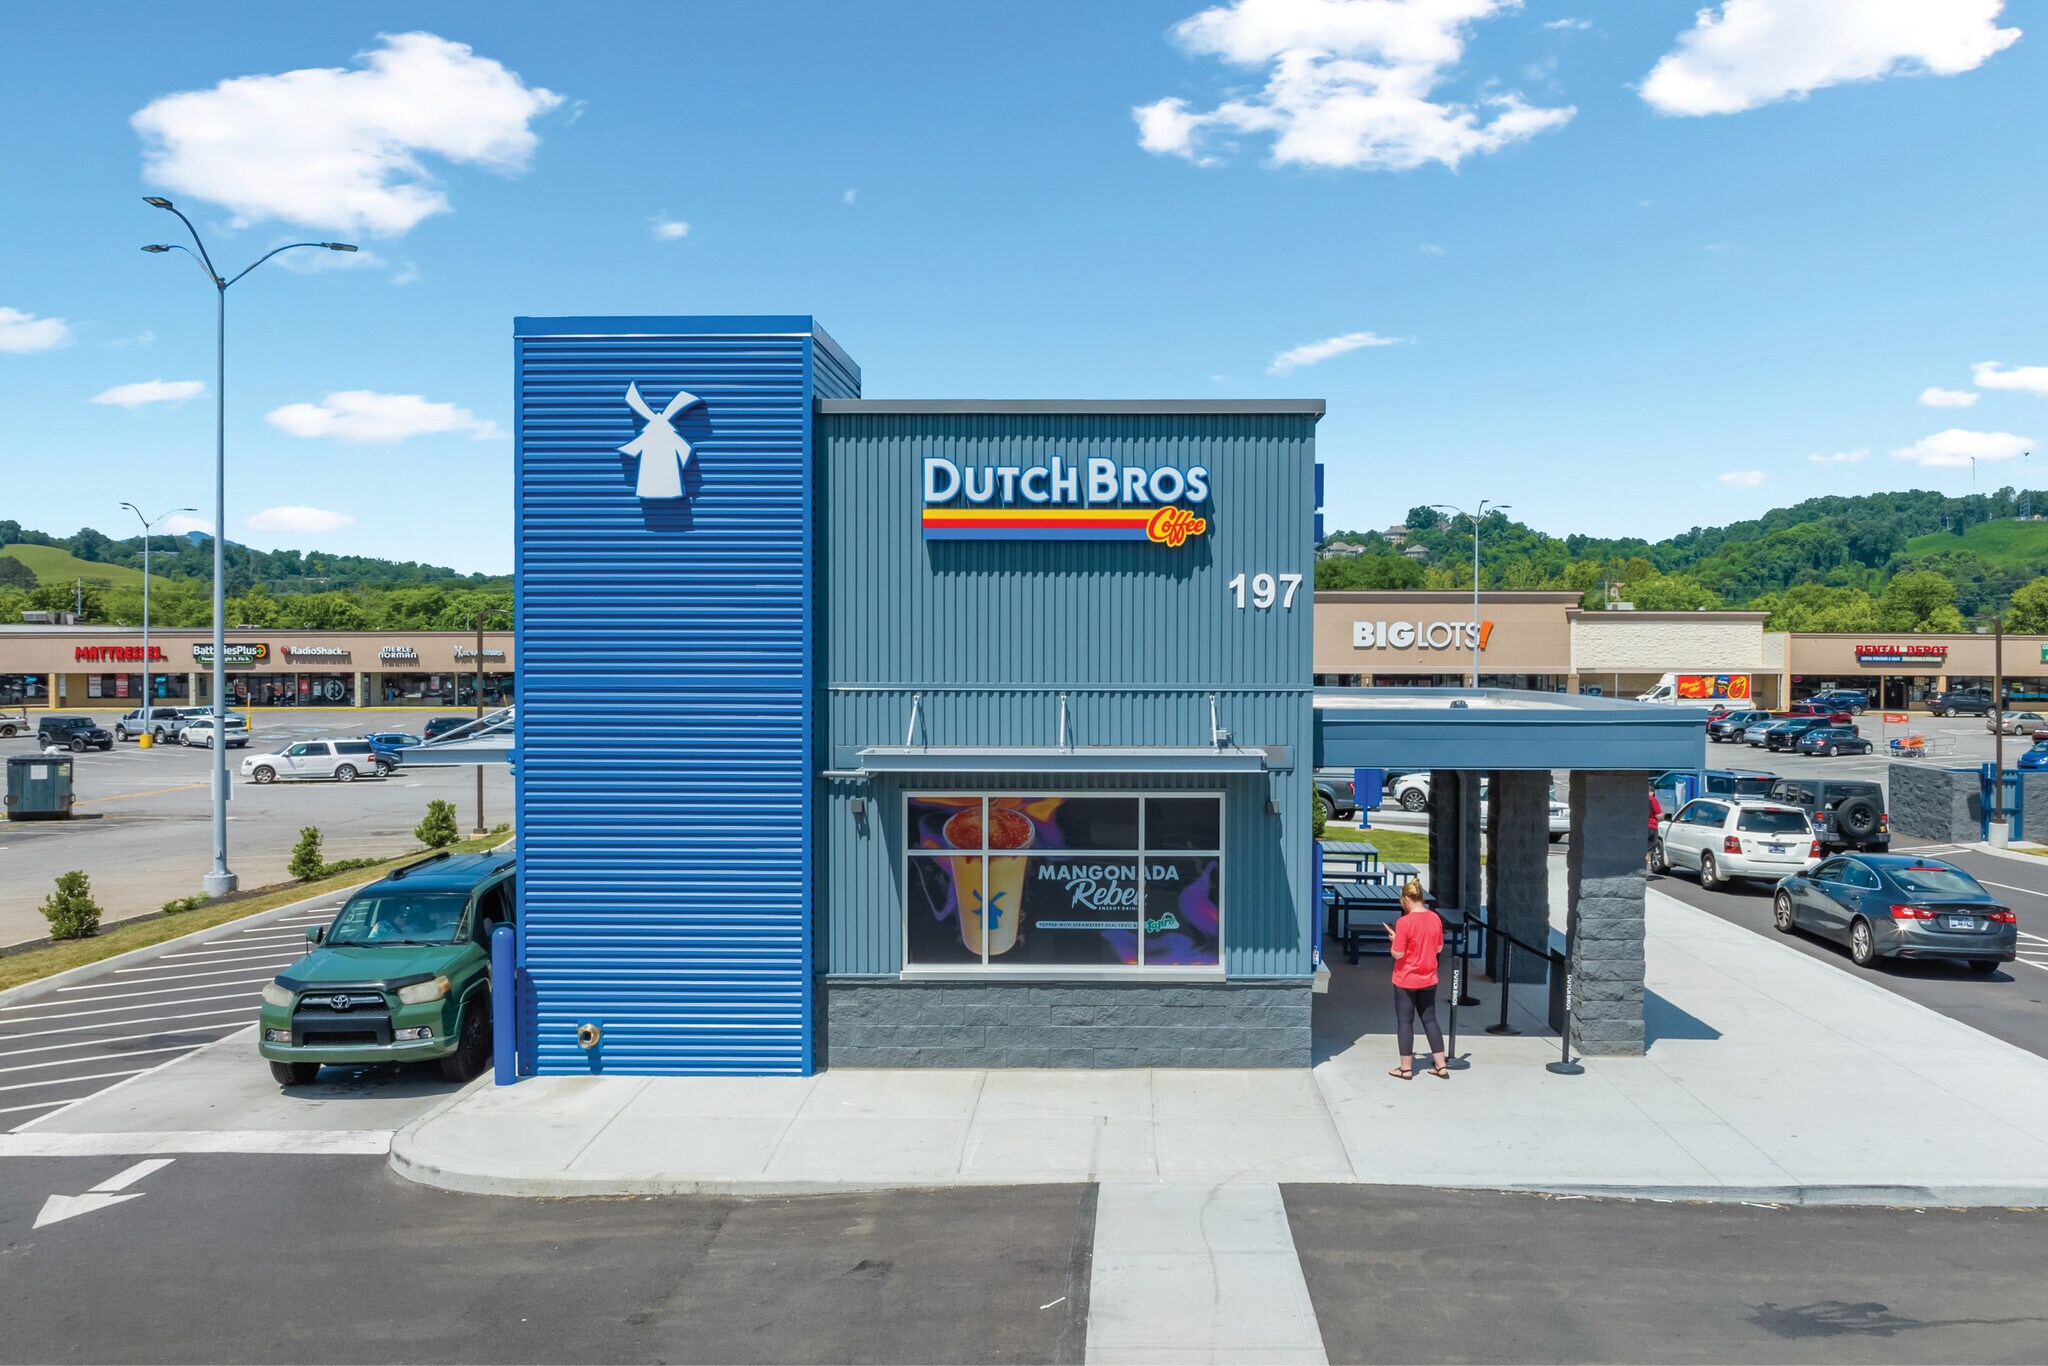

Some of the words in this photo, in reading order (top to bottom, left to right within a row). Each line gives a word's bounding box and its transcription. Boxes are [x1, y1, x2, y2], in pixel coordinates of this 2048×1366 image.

[923, 456, 1079, 503] DUTCH
[1087, 457, 1209, 503] BROS
[1147, 506, 1206, 546] Coffee
[1229, 573, 1303, 609] 197
[193, 645, 257, 655] BattiesPlus
[291, 646, 343, 655] RadioShack
[1855, 645, 1903, 655] RENTAL
[1907, 645, 1949, 656] DEPOT
[1038, 865, 1180, 880] MANGONADA
